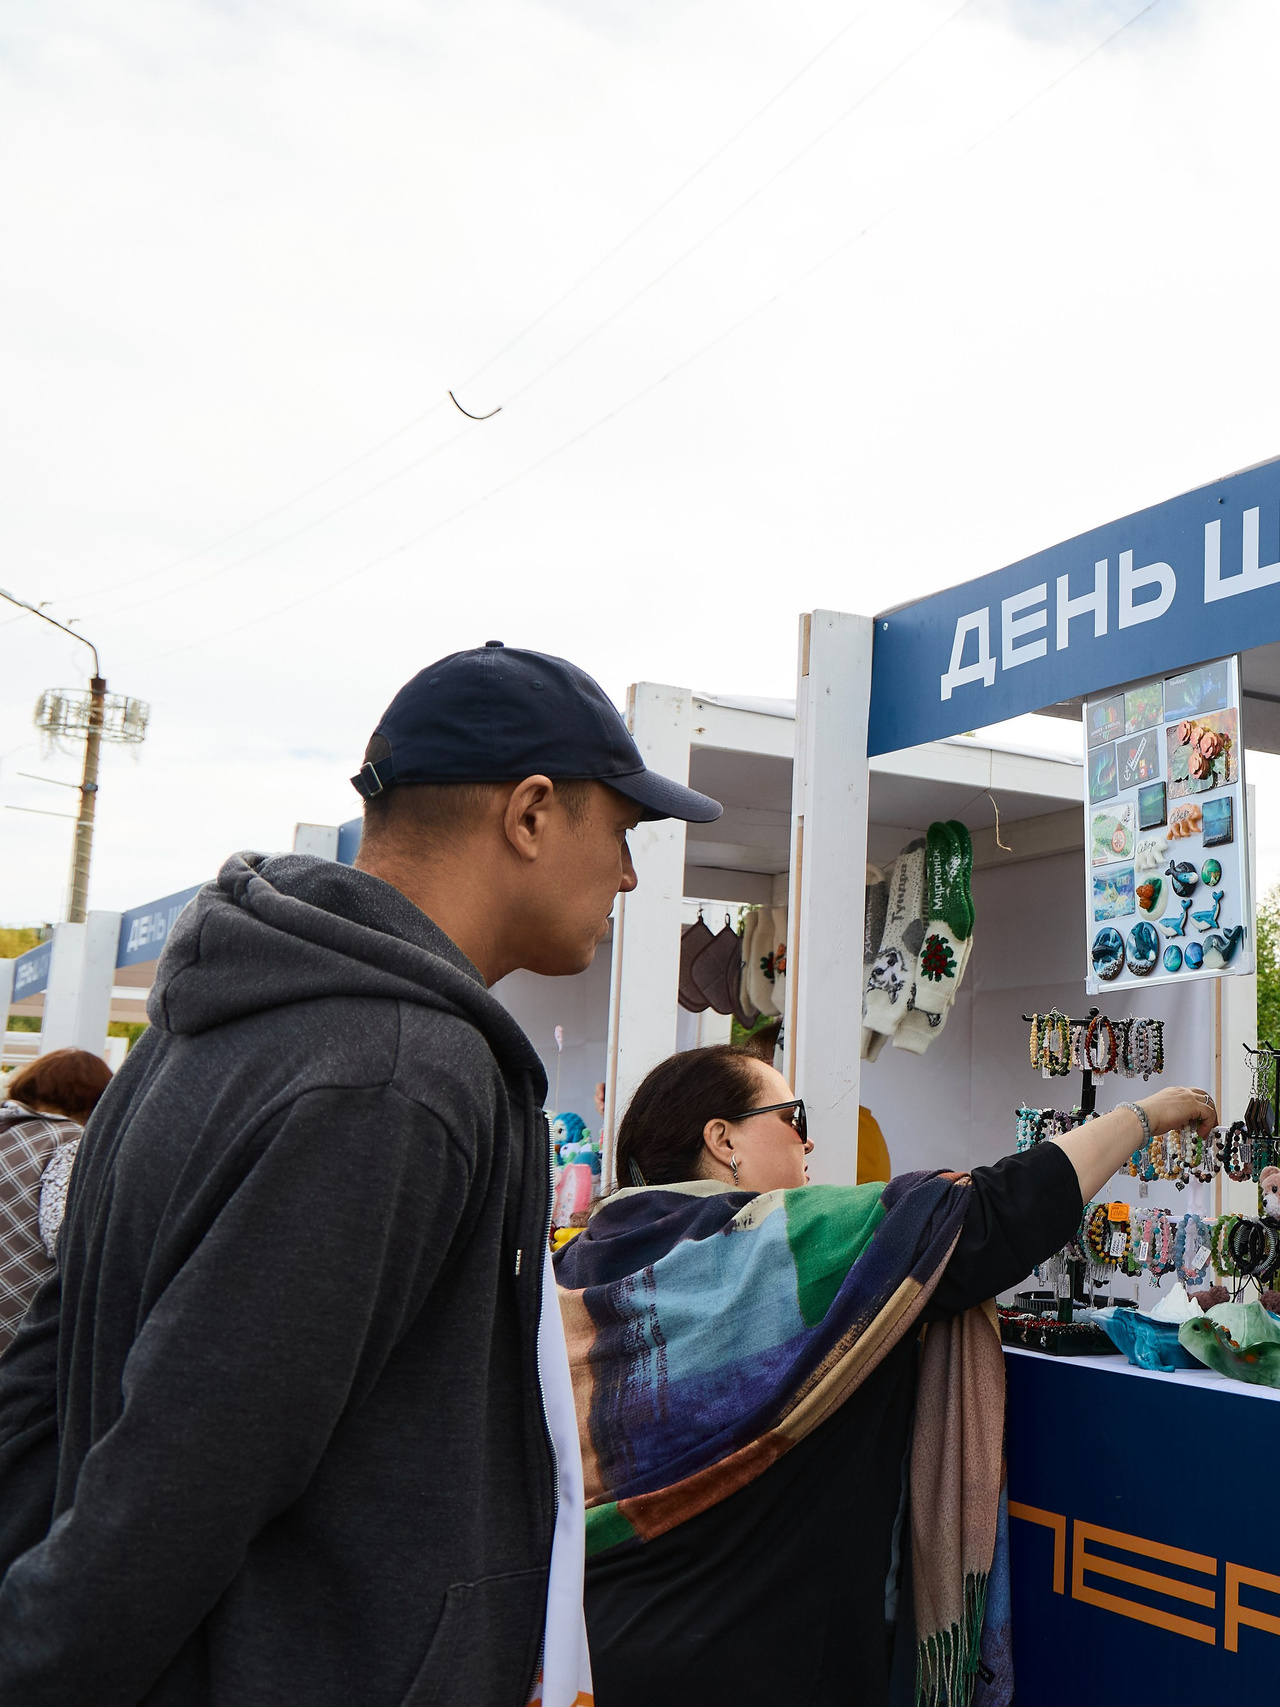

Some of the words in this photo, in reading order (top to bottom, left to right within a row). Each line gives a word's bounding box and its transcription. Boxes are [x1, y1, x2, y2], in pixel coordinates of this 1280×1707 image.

[941, 549, 1177, 701] ДЕНЬ
[891, 863, 908, 924] Тундра
[933, 849, 946, 910] Мурманск
[126, 911, 166, 953] ДЕНЬ
